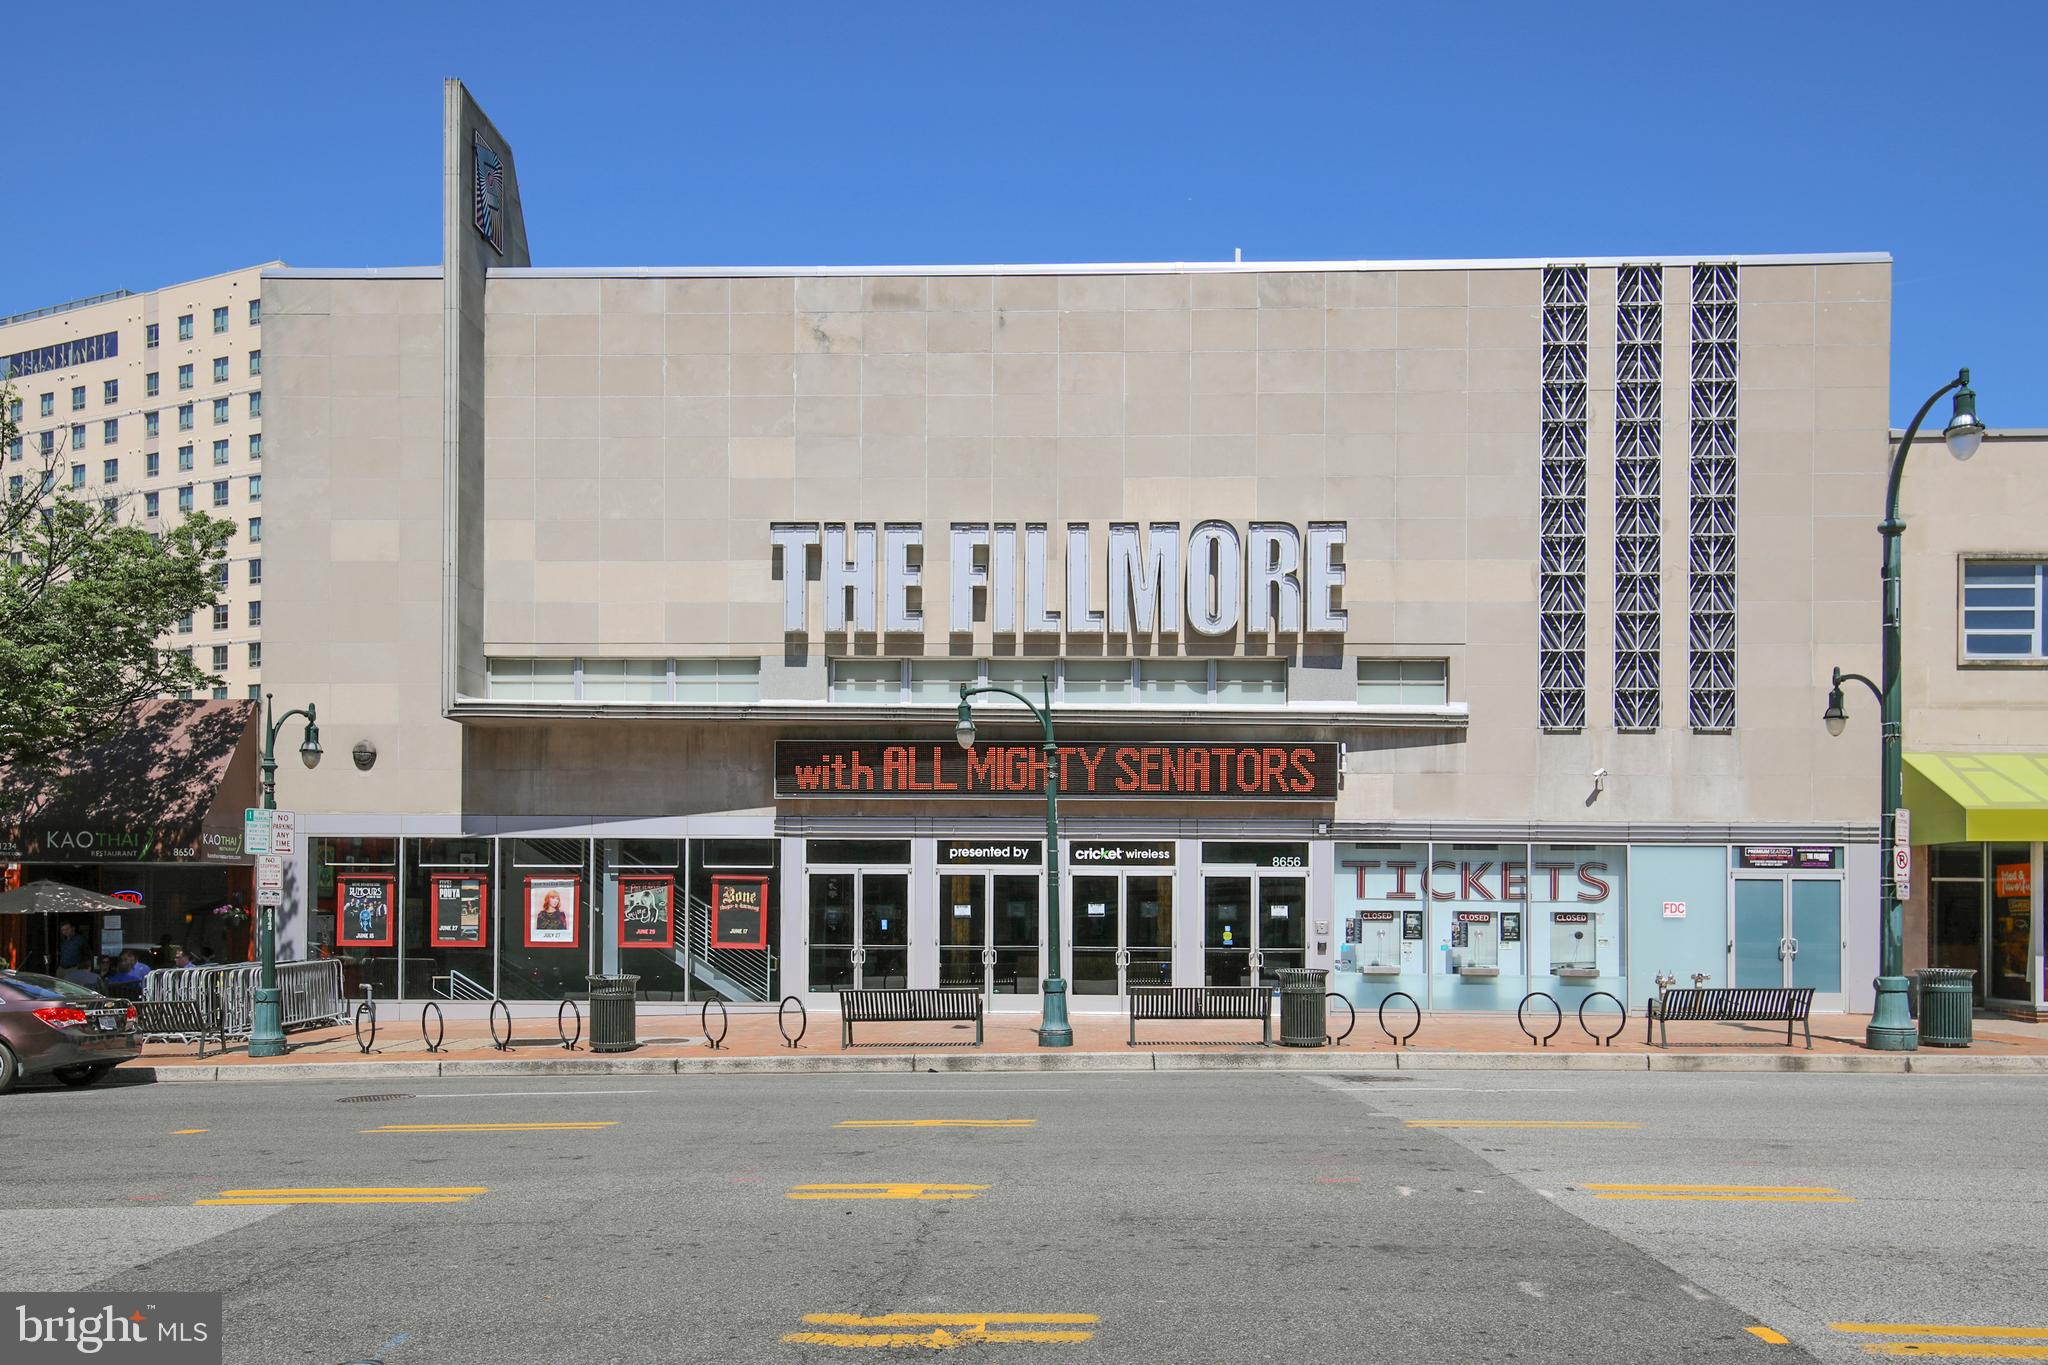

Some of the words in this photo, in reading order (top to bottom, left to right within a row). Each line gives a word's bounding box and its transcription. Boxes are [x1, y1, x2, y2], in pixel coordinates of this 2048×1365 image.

[770, 521, 925, 635] THE
[950, 519, 1348, 637] FILLMORE
[795, 754, 875, 791] with
[883, 745, 957, 791] ALL
[967, 746, 1106, 792] MIGHTY
[1115, 747, 1316, 793] SENATORS
[173, 848, 195, 857] 8650
[949, 846, 1010, 860] presented
[1013, 846, 1029, 860] by
[1075, 847, 1122, 860] cricket
[1125, 848, 1170, 859] wireless
[1272, 856, 1301, 867] 8656
[1342, 860, 1611, 902] TICKETS
[349, 887, 382, 898] RUMOURS
[439, 888, 460, 898] POUYA
[722, 886, 757, 904] Bone
[1663, 903, 1685, 914] FDC
[1362, 912, 1392, 920] CLOSED
[1459, 913, 1489, 922] CLOSED
[1556, 914, 1587, 922] CLOSED
